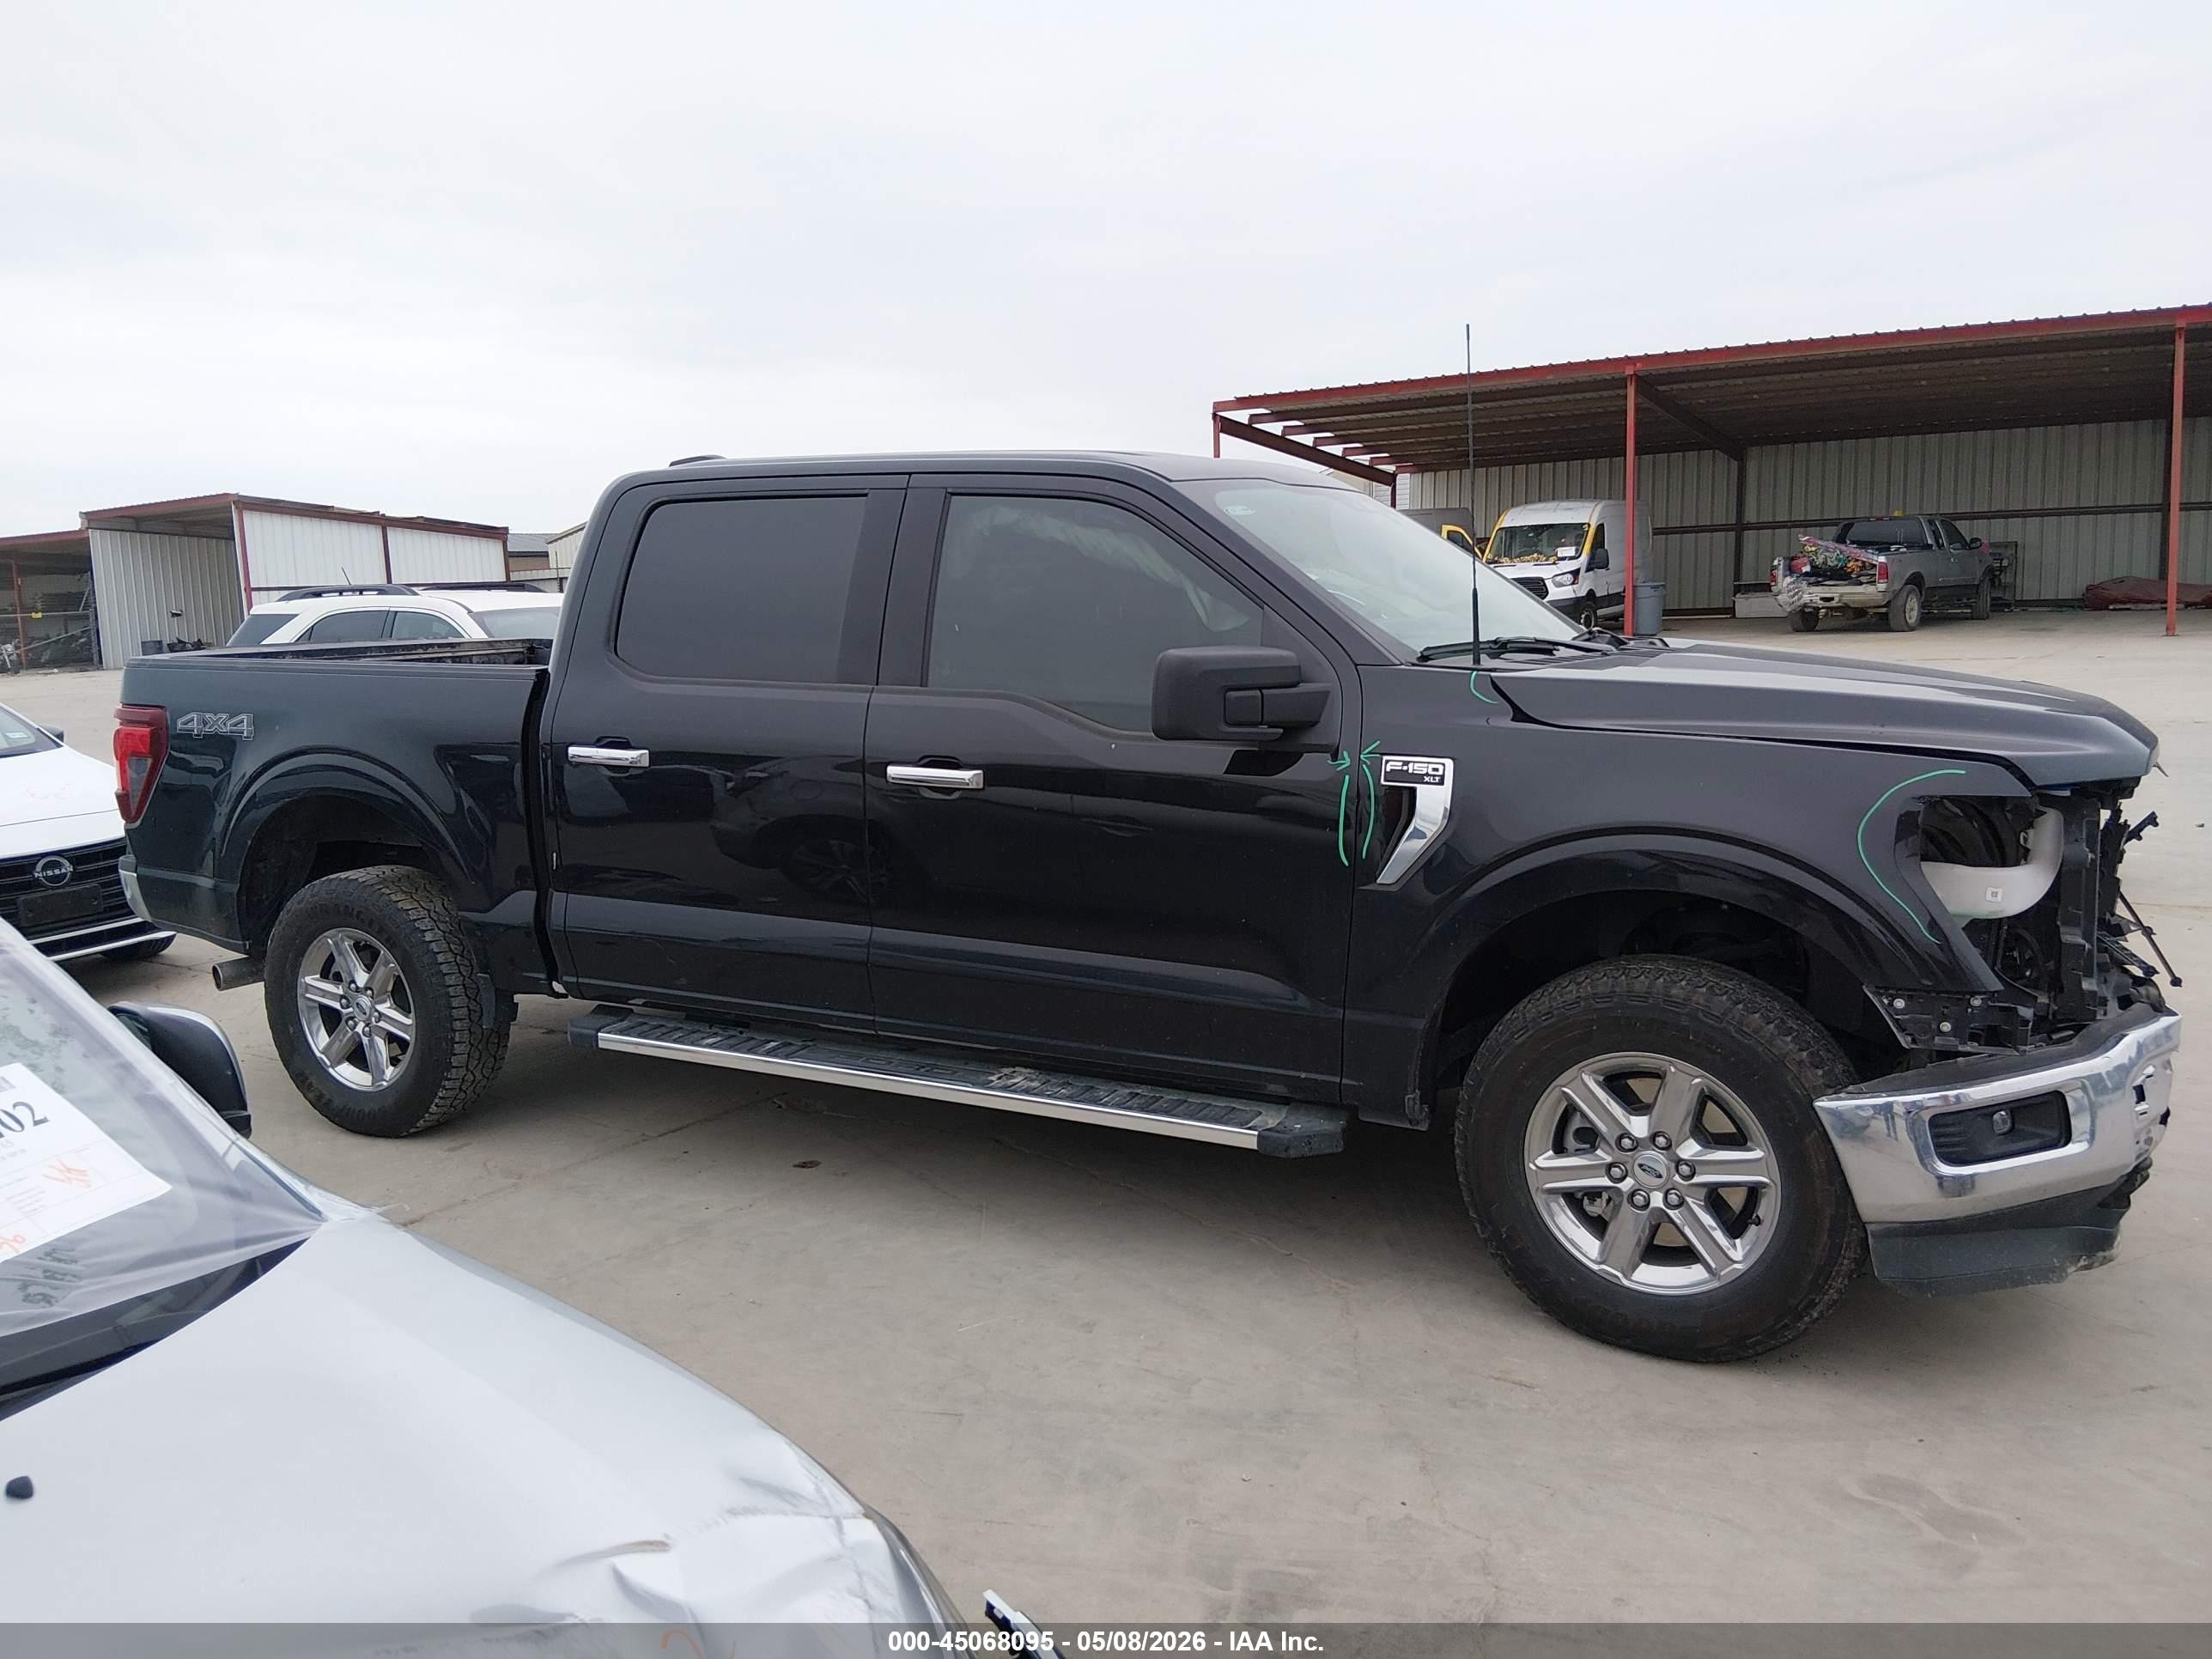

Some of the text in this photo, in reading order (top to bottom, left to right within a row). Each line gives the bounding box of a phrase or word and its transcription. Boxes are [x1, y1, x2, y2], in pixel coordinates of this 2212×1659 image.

[1386, 761, 1444, 775] F-150
[34, 864, 74, 878] NISSAN
[0, 1101, 50, 1139] 02
